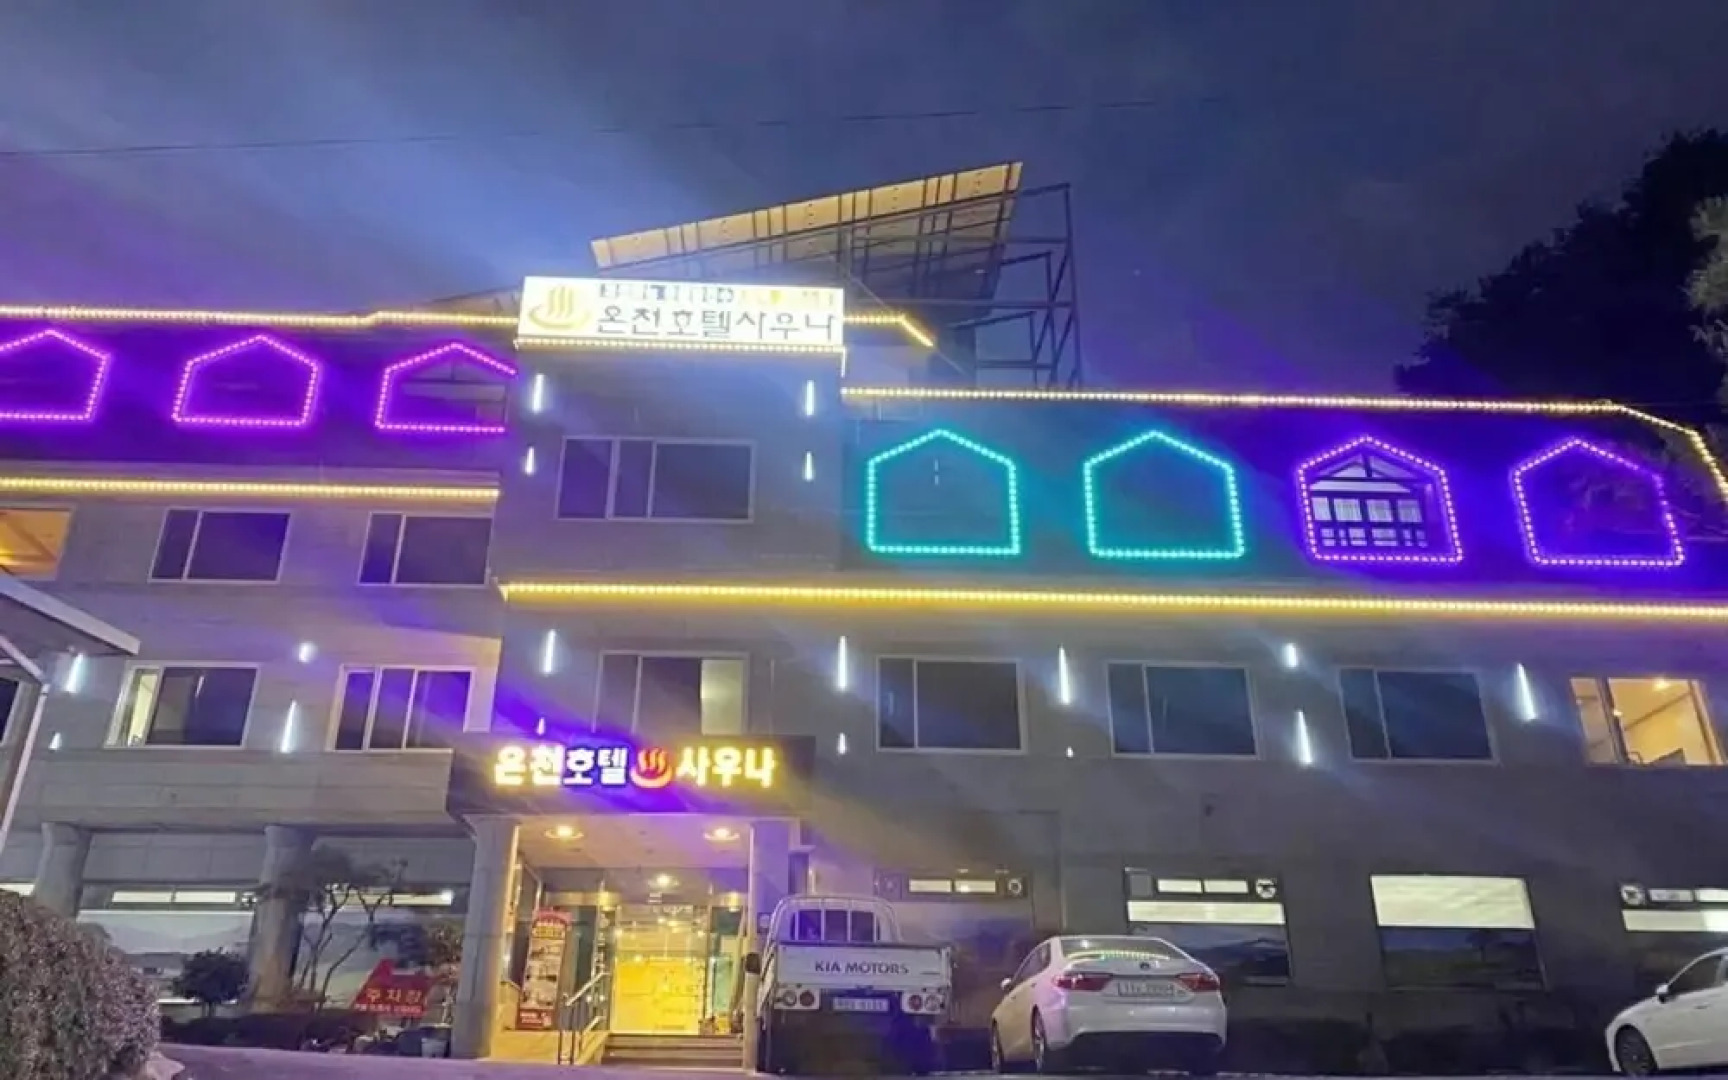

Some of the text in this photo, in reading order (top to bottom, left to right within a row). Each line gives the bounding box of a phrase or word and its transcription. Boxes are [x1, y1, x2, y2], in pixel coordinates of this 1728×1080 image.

[494, 745, 777, 788] 온천호텔 사우나
[815, 960, 909, 975] KIA MOTORS
